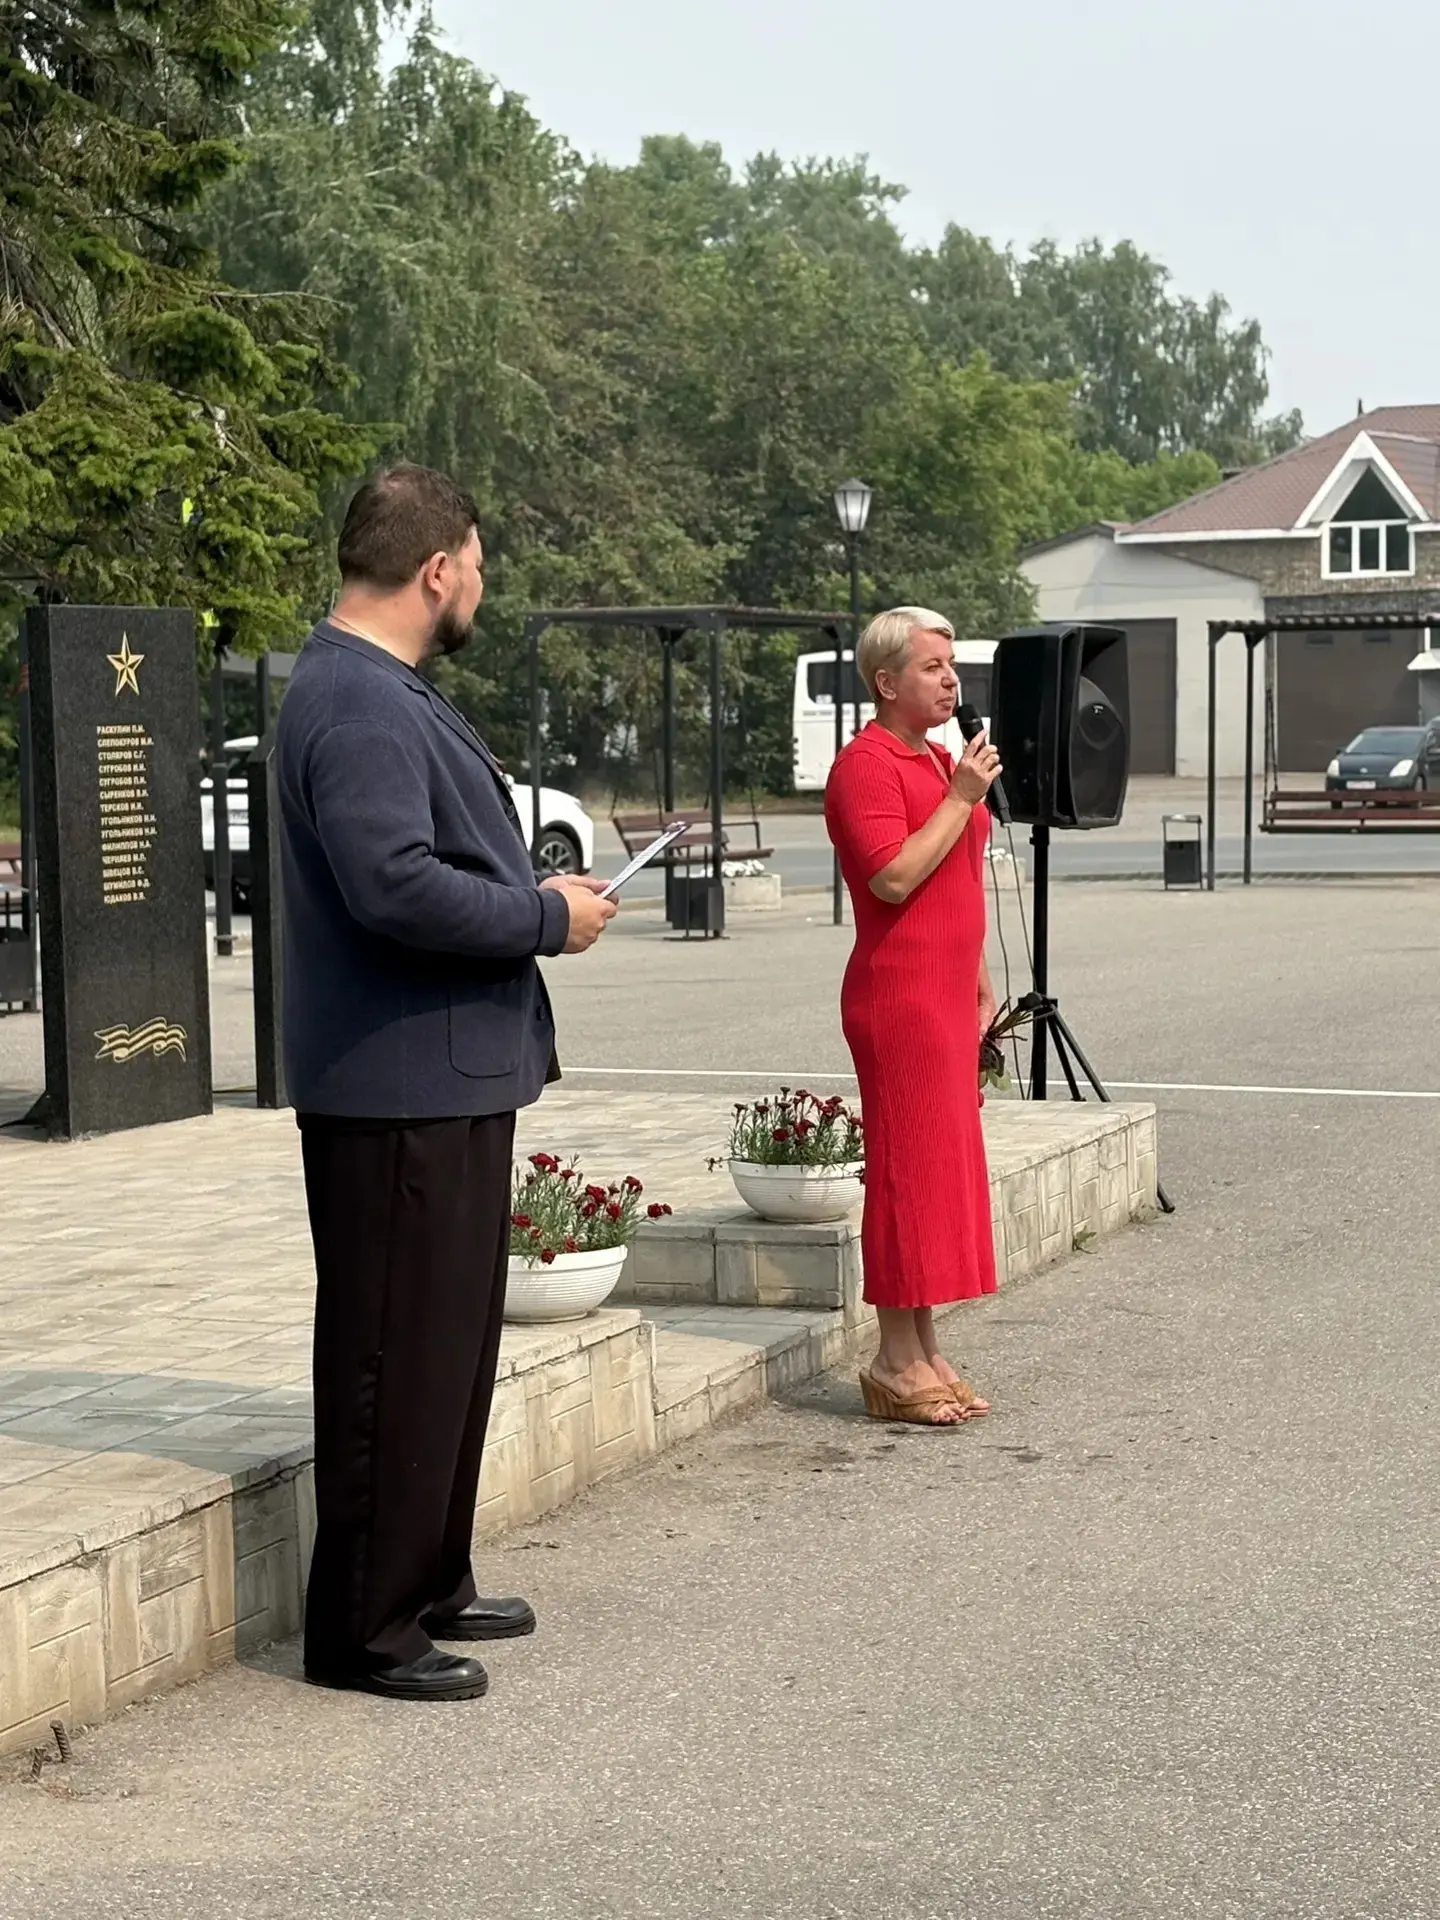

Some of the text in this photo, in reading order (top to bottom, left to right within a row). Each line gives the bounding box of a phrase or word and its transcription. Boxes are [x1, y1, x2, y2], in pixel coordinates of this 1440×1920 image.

[97, 738, 139, 748] СЛЕПОКУРОВ
[98, 750, 147, 761] СТОЛЯРОВ С.Г.
[98, 763, 132, 774] СУГРОБОВ
[99, 776, 133, 787] СУГРОБОВ
[99, 802, 129, 813] ТЕРСКОВ
[101, 815, 143, 826] УГОЛЬНИКОВ
[101, 827, 143, 839] УГОЛЬНИКОВ
[101, 840, 138, 851] ФИЛИППОВ
[103, 867, 131, 878] ШВЕЦОВ
[104, 893, 132, 904] ЮДАКОВ
